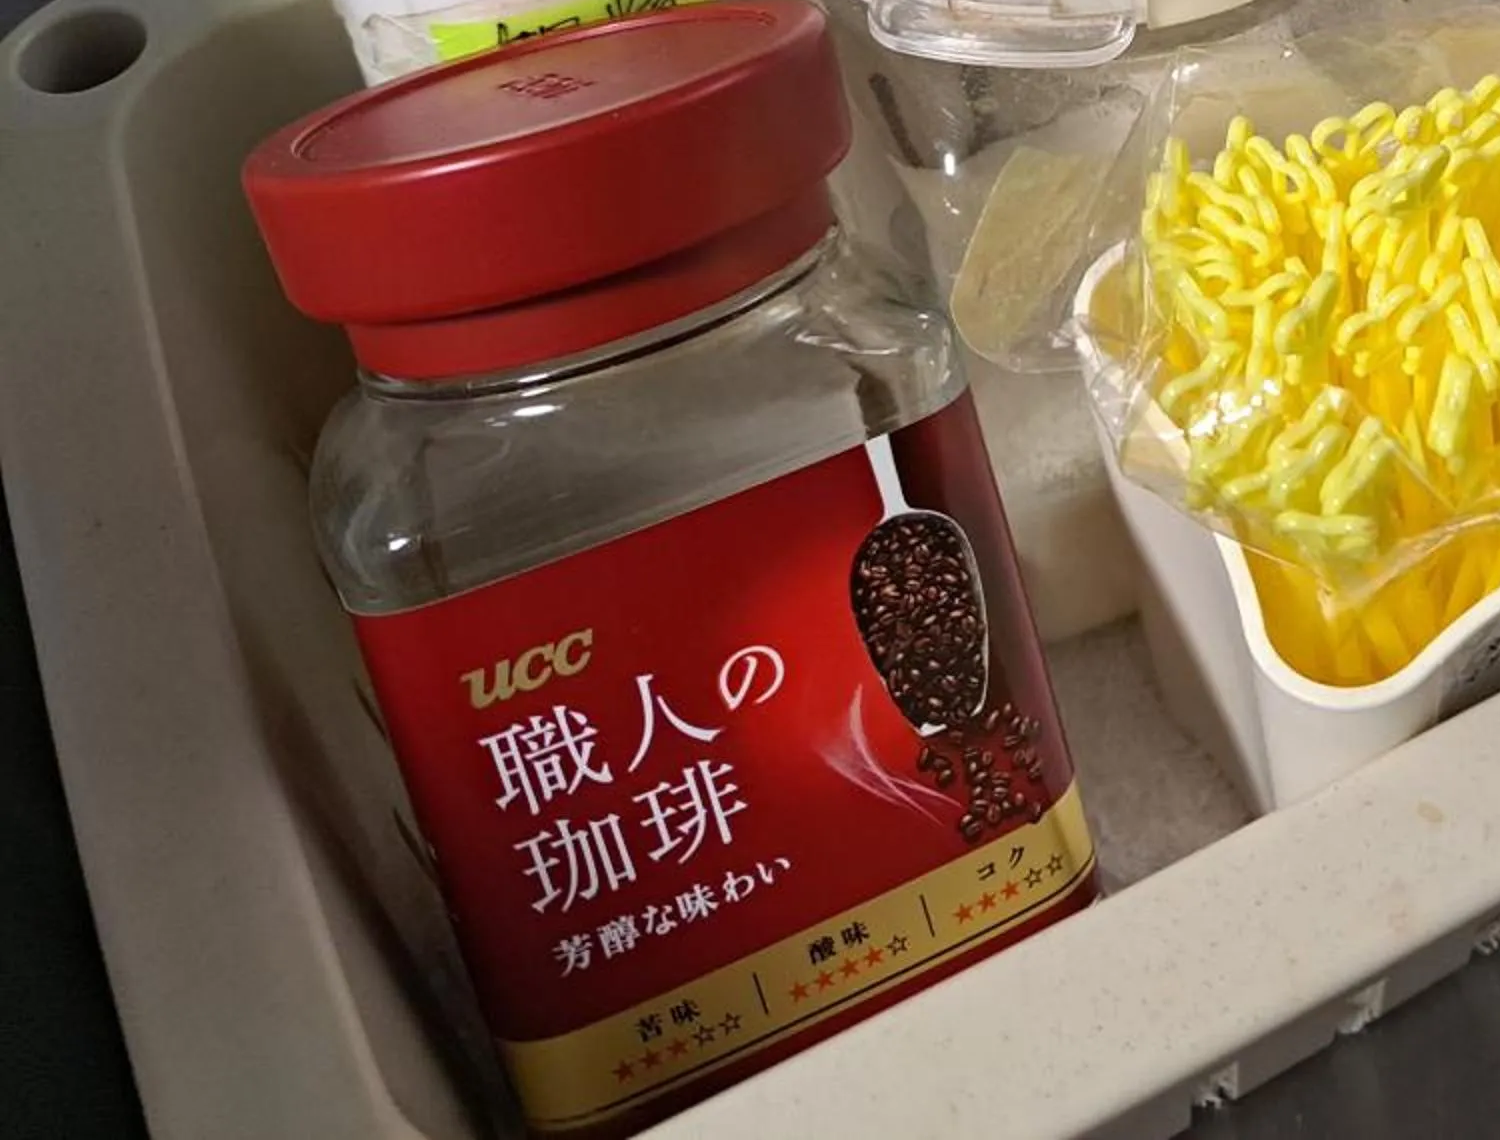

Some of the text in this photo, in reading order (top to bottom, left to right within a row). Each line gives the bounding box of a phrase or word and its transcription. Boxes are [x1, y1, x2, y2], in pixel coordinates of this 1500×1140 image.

[479, 645, 786, 818] 職人の
[513, 759, 748, 916] 珈琲
[976, 845, 1026, 882] コク
[552, 856, 792, 978] 芳醇な味わい
[806, 921, 871, 966] 酸味
[633, 998, 702, 1044] 苦味
